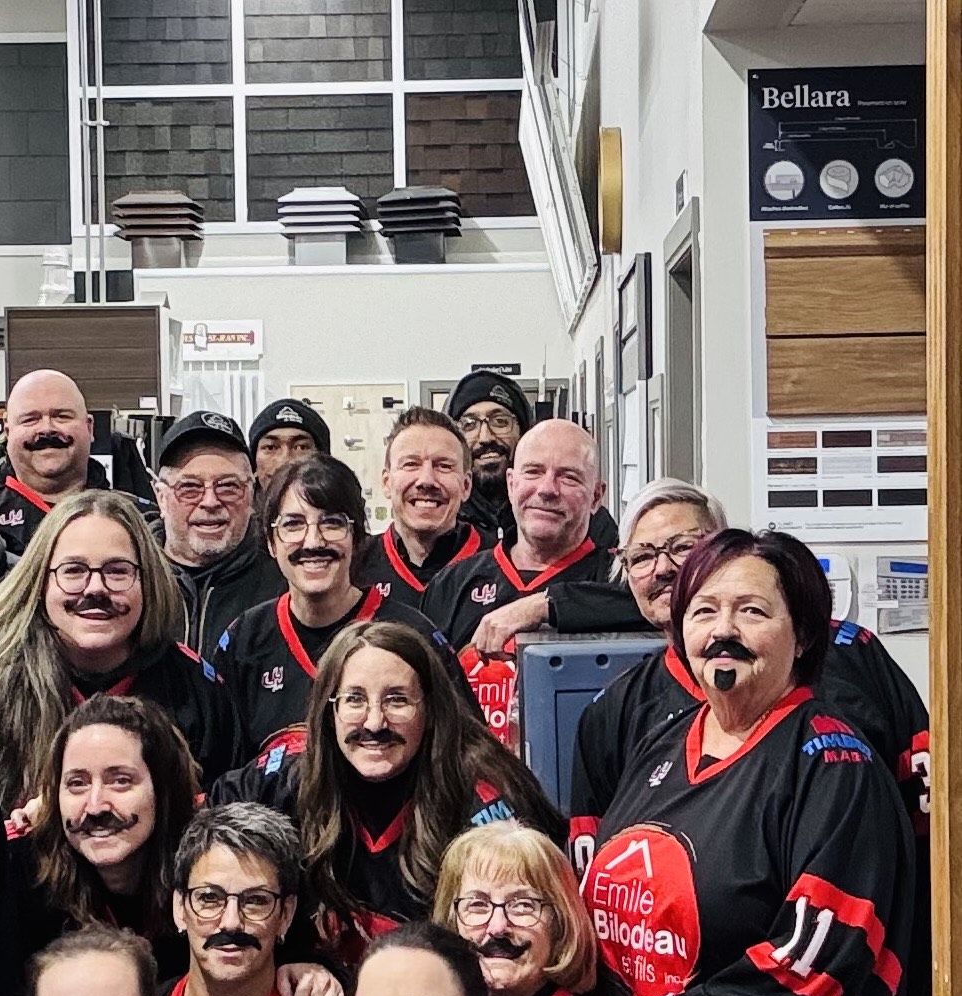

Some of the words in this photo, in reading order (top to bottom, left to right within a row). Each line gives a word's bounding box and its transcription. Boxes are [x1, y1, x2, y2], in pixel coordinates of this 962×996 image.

[761, 84, 851, 109] Bellara
[593, 871, 655, 915] Emile
[593, 908, 688, 960] Bilodeau
[633, 954, 656, 983] fils
